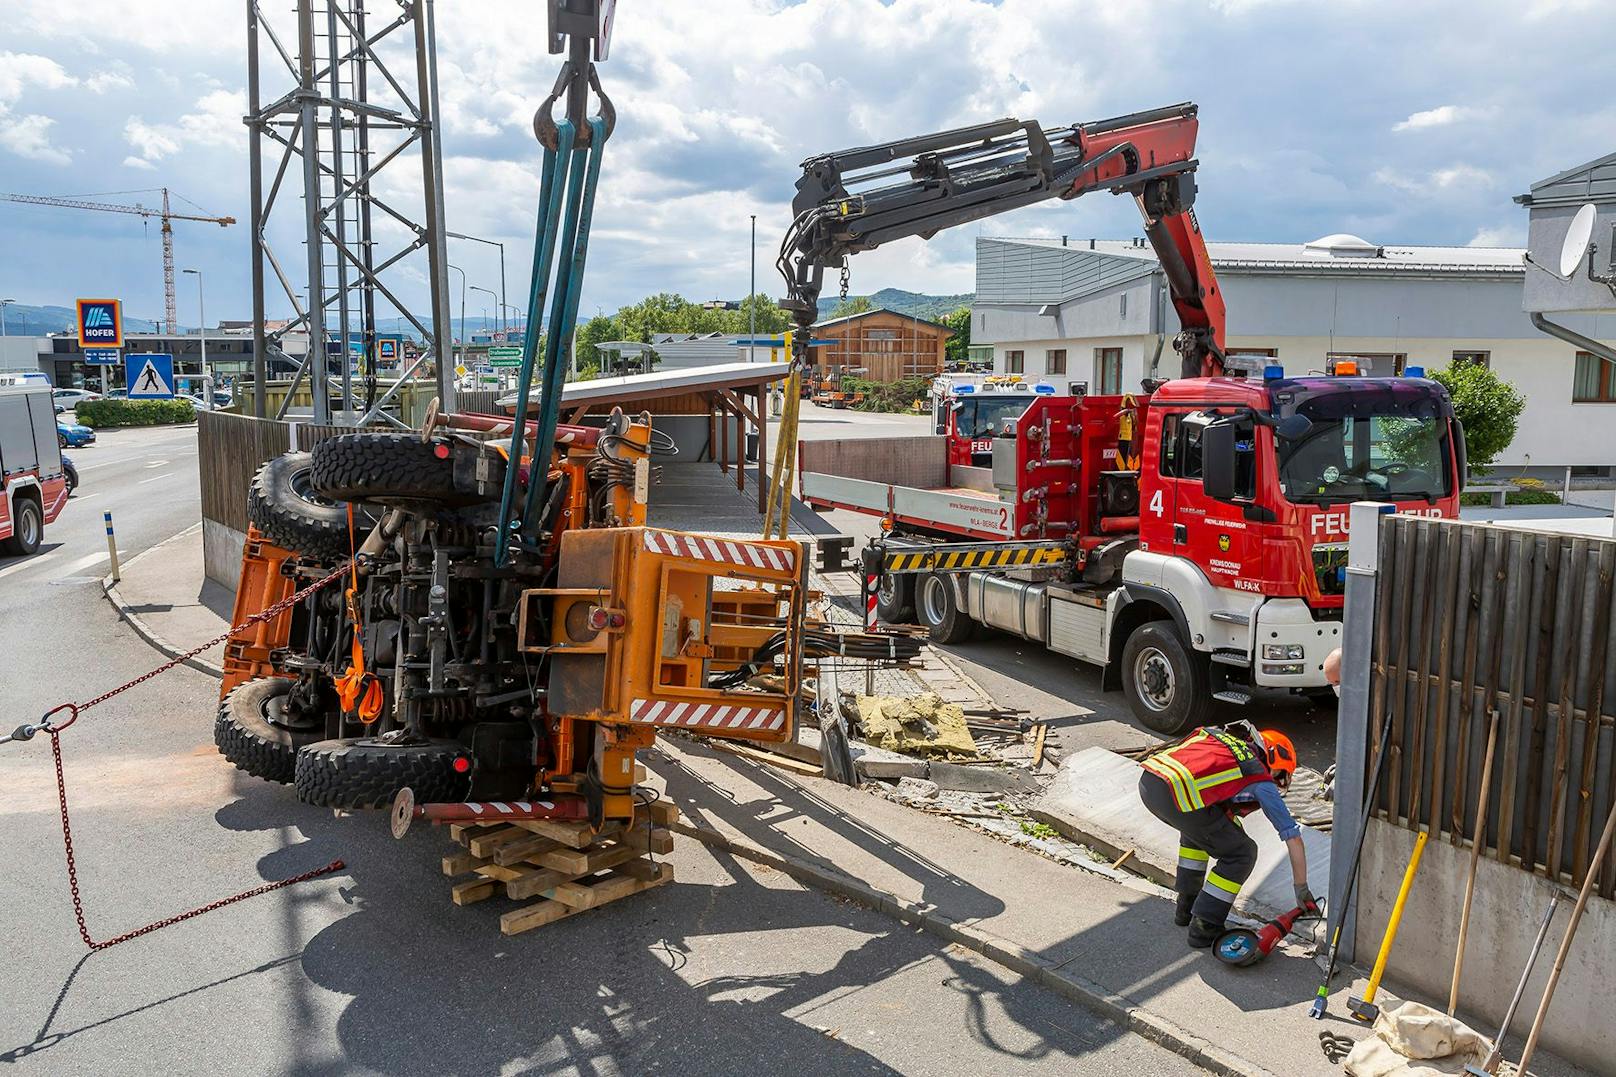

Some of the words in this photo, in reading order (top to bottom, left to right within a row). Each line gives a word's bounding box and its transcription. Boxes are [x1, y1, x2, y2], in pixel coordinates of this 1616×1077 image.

[85, 329, 115, 337] HOFER
[1149, 489, 1164, 518] 4
[999, 507, 1008, 530] 2
[1234, 579, 1261, 592] WLFA-K
